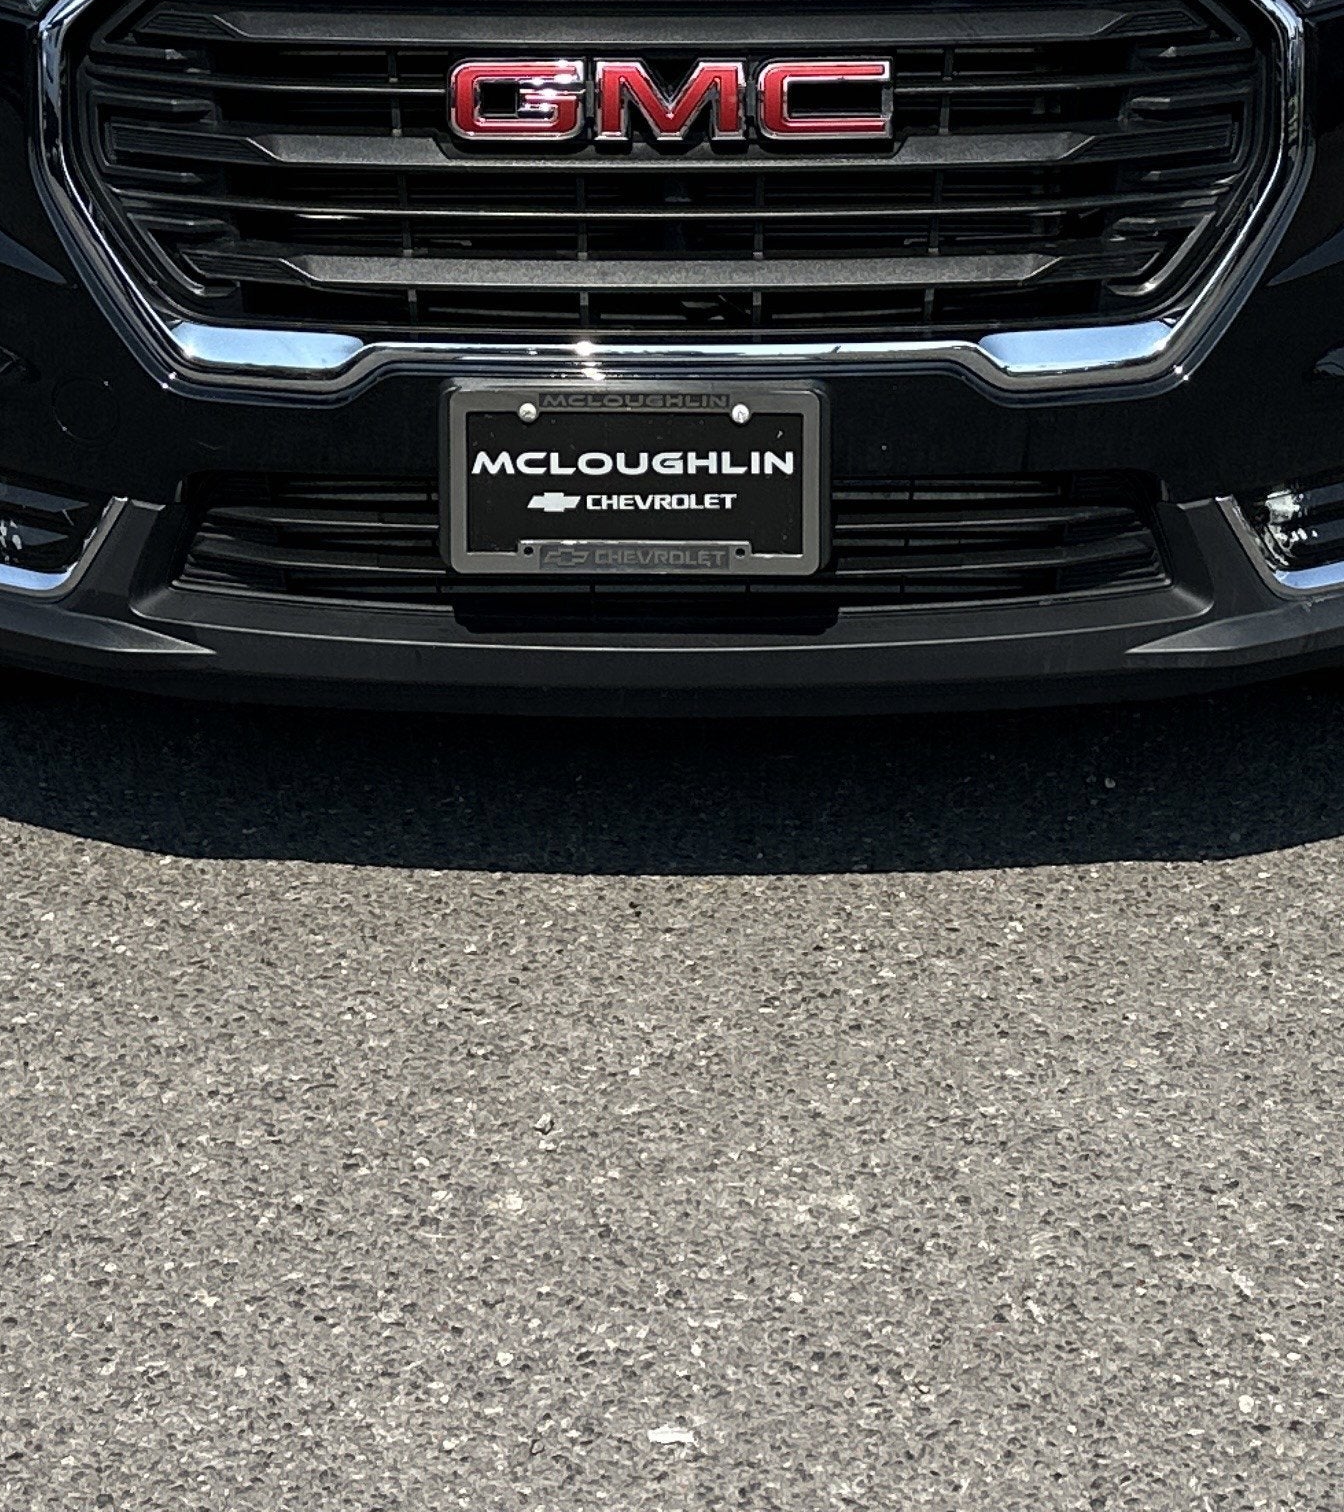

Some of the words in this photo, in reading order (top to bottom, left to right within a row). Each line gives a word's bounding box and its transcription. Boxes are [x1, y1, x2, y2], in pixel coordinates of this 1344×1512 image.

[450, 57, 893, 141] GMC
[542, 393, 727, 409] MCLOUGHLIN
[471, 451, 794, 476] MCLOUGHLIN
[586, 492, 737, 510] CHEVROLET
[594, 548, 727, 569] CHEVROLET
